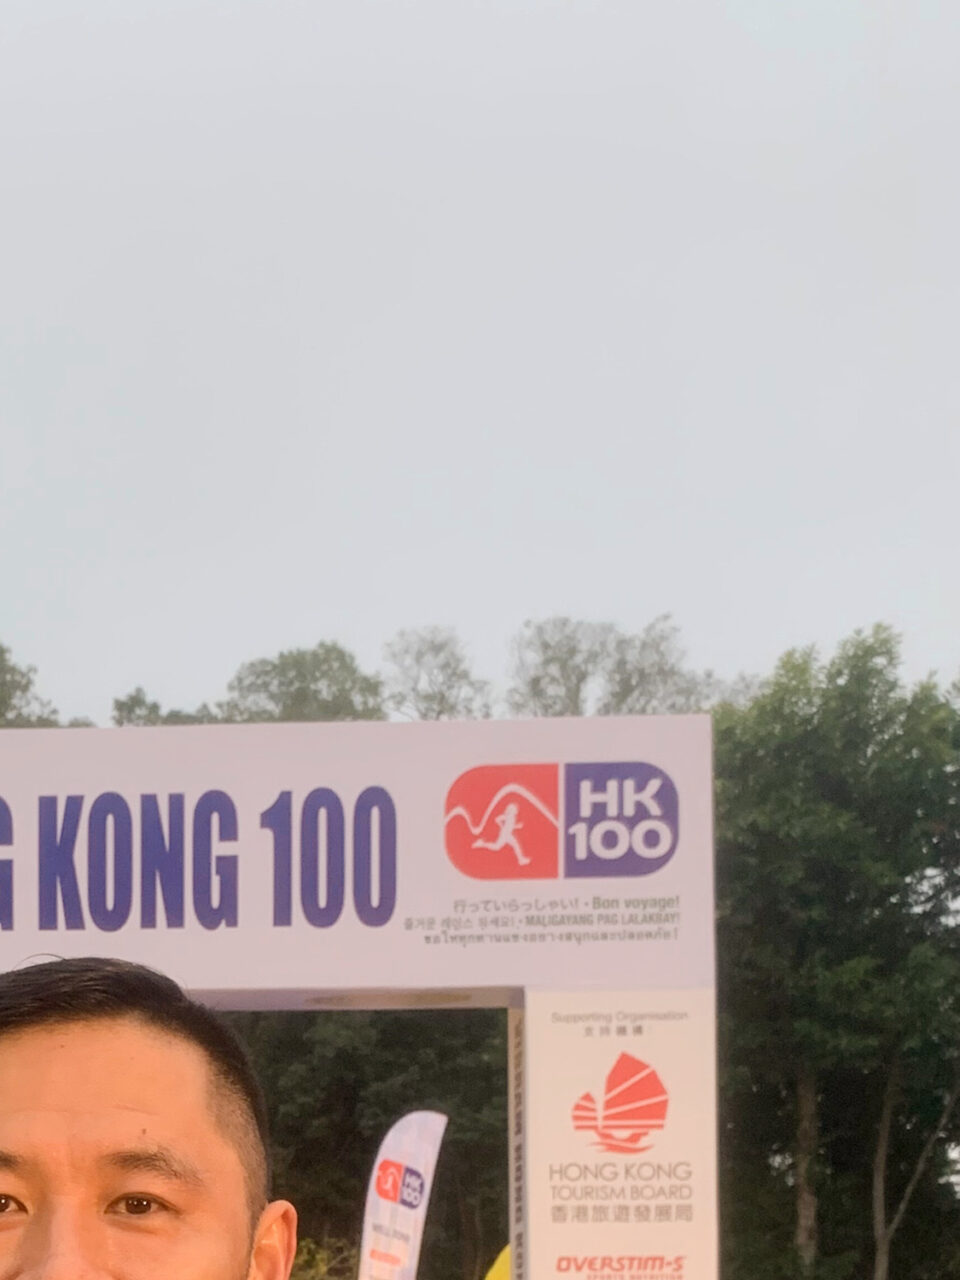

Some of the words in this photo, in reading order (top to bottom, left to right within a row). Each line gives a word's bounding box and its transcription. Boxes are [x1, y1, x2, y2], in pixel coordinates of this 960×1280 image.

[580, 778, 663, 818] HK
[567, 821, 674, 861] 100
[38, 788, 240, 933] KONG
[259, 785, 398, 929] 100
[592, 896, 620, 910] Bon
[624, 895, 681, 912] voyage!
[548, 1162, 619, 1182] HONG
[624, 1161, 693, 1182] KONG
[551, 1185, 626, 1201] TOURISM
[630, 1184, 693, 1201] BOARD
[551, 1203, 693, 1223] 香港旅遊發展局
